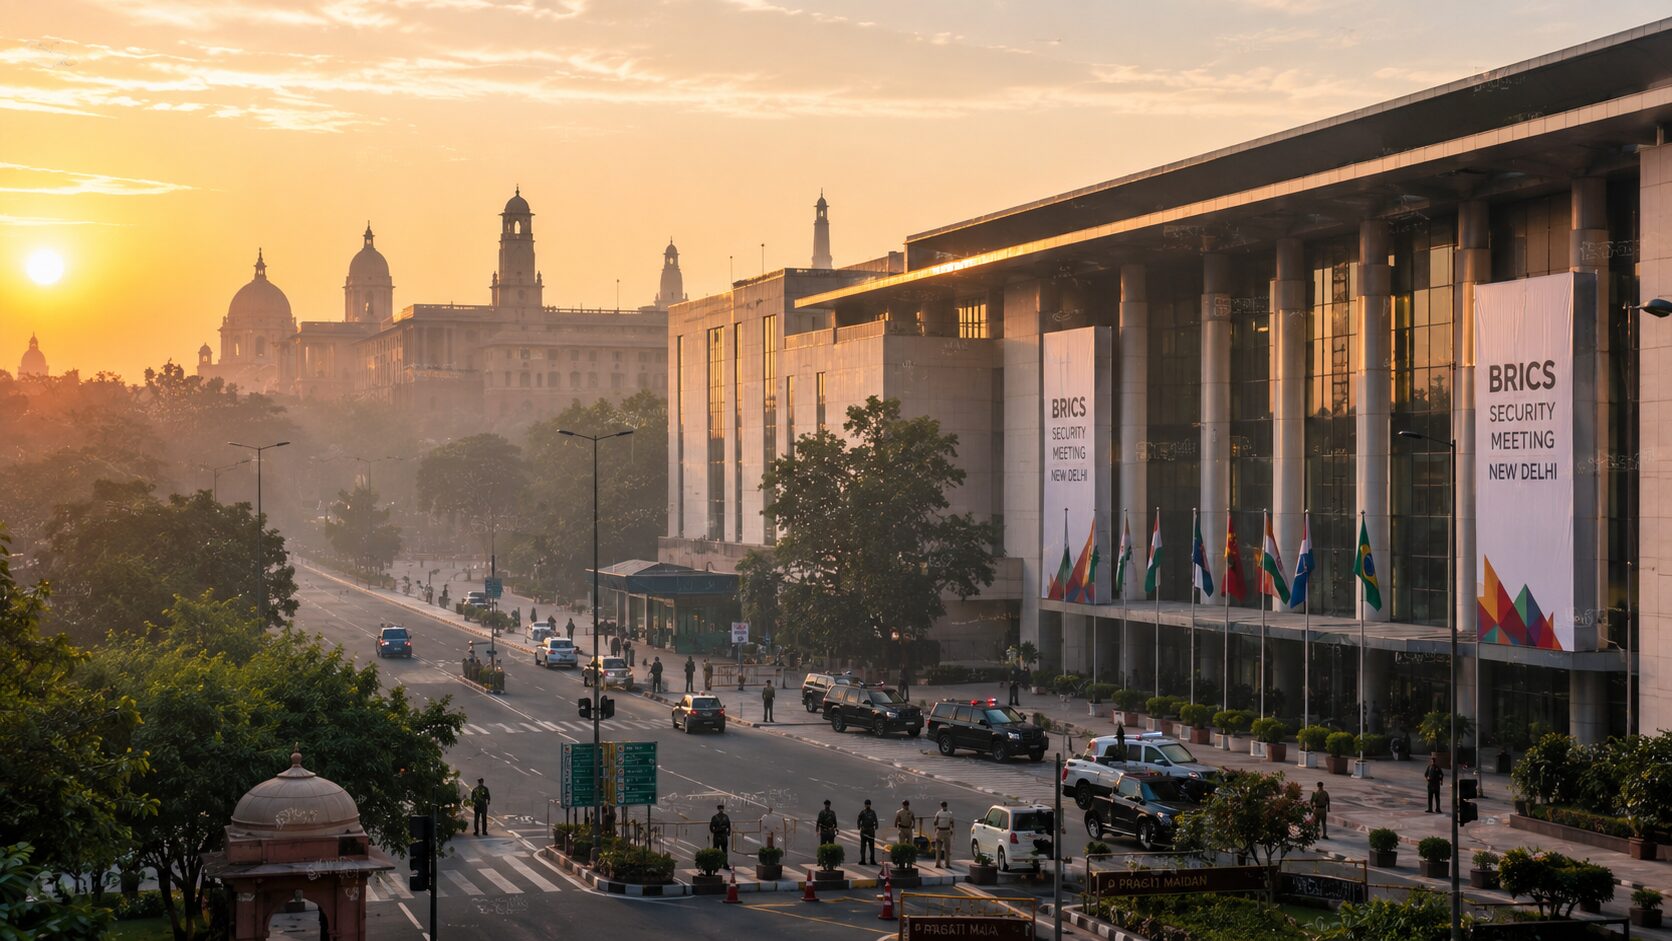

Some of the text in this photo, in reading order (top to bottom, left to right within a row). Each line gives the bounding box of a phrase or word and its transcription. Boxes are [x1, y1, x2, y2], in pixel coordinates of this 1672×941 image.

[1489, 360, 1556, 392] BRICS
[1052, 396, 1086, 418] BRICS
[1489, 402, 1556, 422] SECURITY
[1052, 426, 1086, 440] SECURITY
[1491, 430, 1555, 450] MEETING
[1052, 446, 1086, 460] MEETING
[1051, 469, 1087, 482] NEW DELHI
[1489, 463, 1557, 480] NEW DELHI
[1164, 876, 1207, 887] MAIDAN
